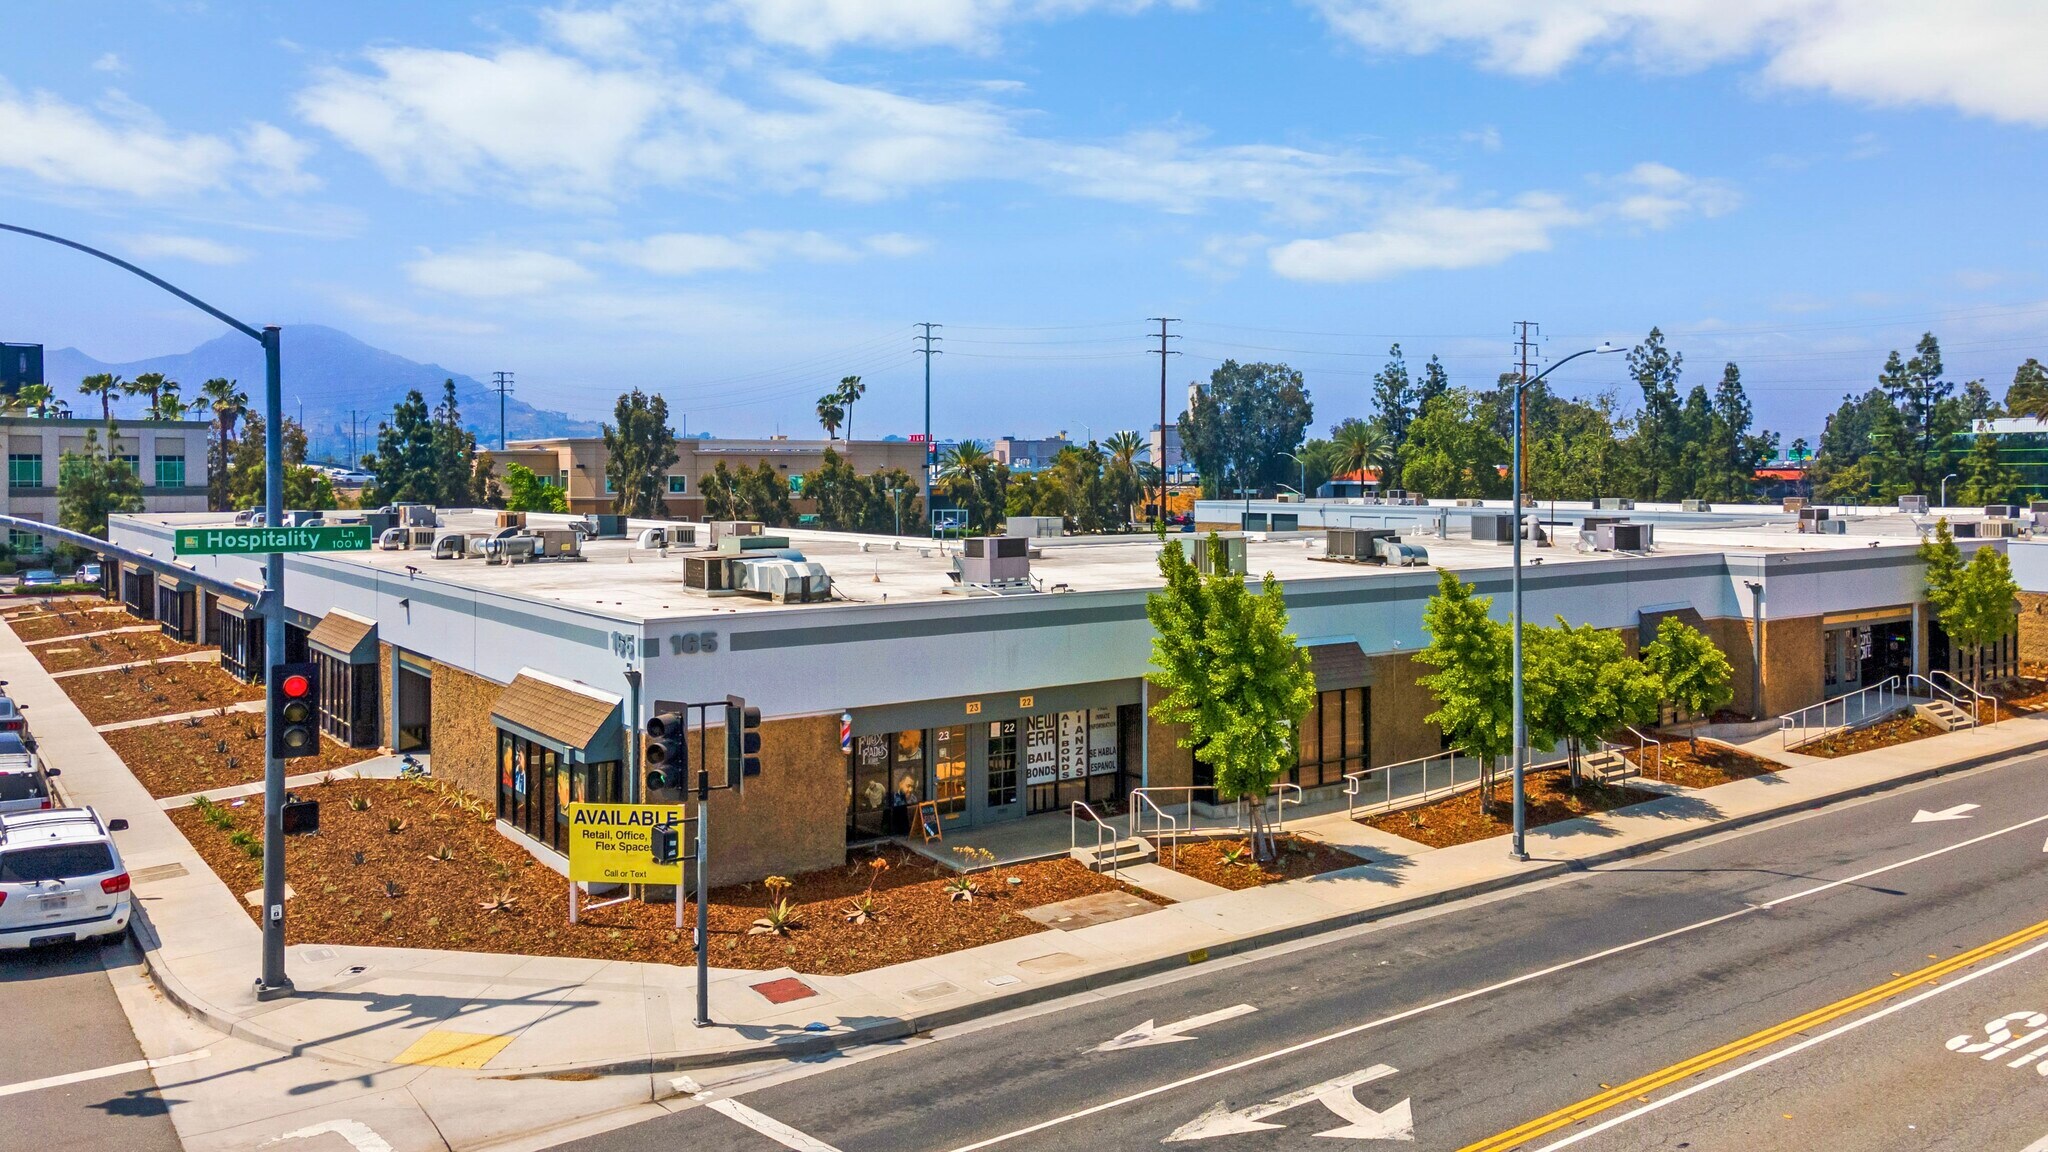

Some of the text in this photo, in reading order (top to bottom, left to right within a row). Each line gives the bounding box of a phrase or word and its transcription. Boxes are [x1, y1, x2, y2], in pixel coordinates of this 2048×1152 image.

[342, 530, 354, 538] Ln
[207, 531, 320, 550] Hospitality
[332, 540, 364, 549] 100 W
[670, 632, 718, 655] 165
[969, 703, 979, 712] 23
[1022, 698, 1031, 706] 22
[1004, 723, 1015, 732] 22
[1027, 713, 1055, 731] NEW
[938, 731, 950, 741] 23
[1027, 729, 1055, 747] ERA
[1075, 711, 1084, 776] IANZAS
[1027, 752, 1055, 764] BAIL
[1089, 747, 1116, 758] SE HABLA
[1061, 740, 1070, 778] BONDS
[1026, 765, 1056, 778] BONDS
[574, 810, 678, 827] AVAILABLE
[582, 830, 648, 841] Retail, Office,
[596, 841, 616, 851] Flex
[604, 869, 618, 877] Call
[630, 870, 647, 878] Text
